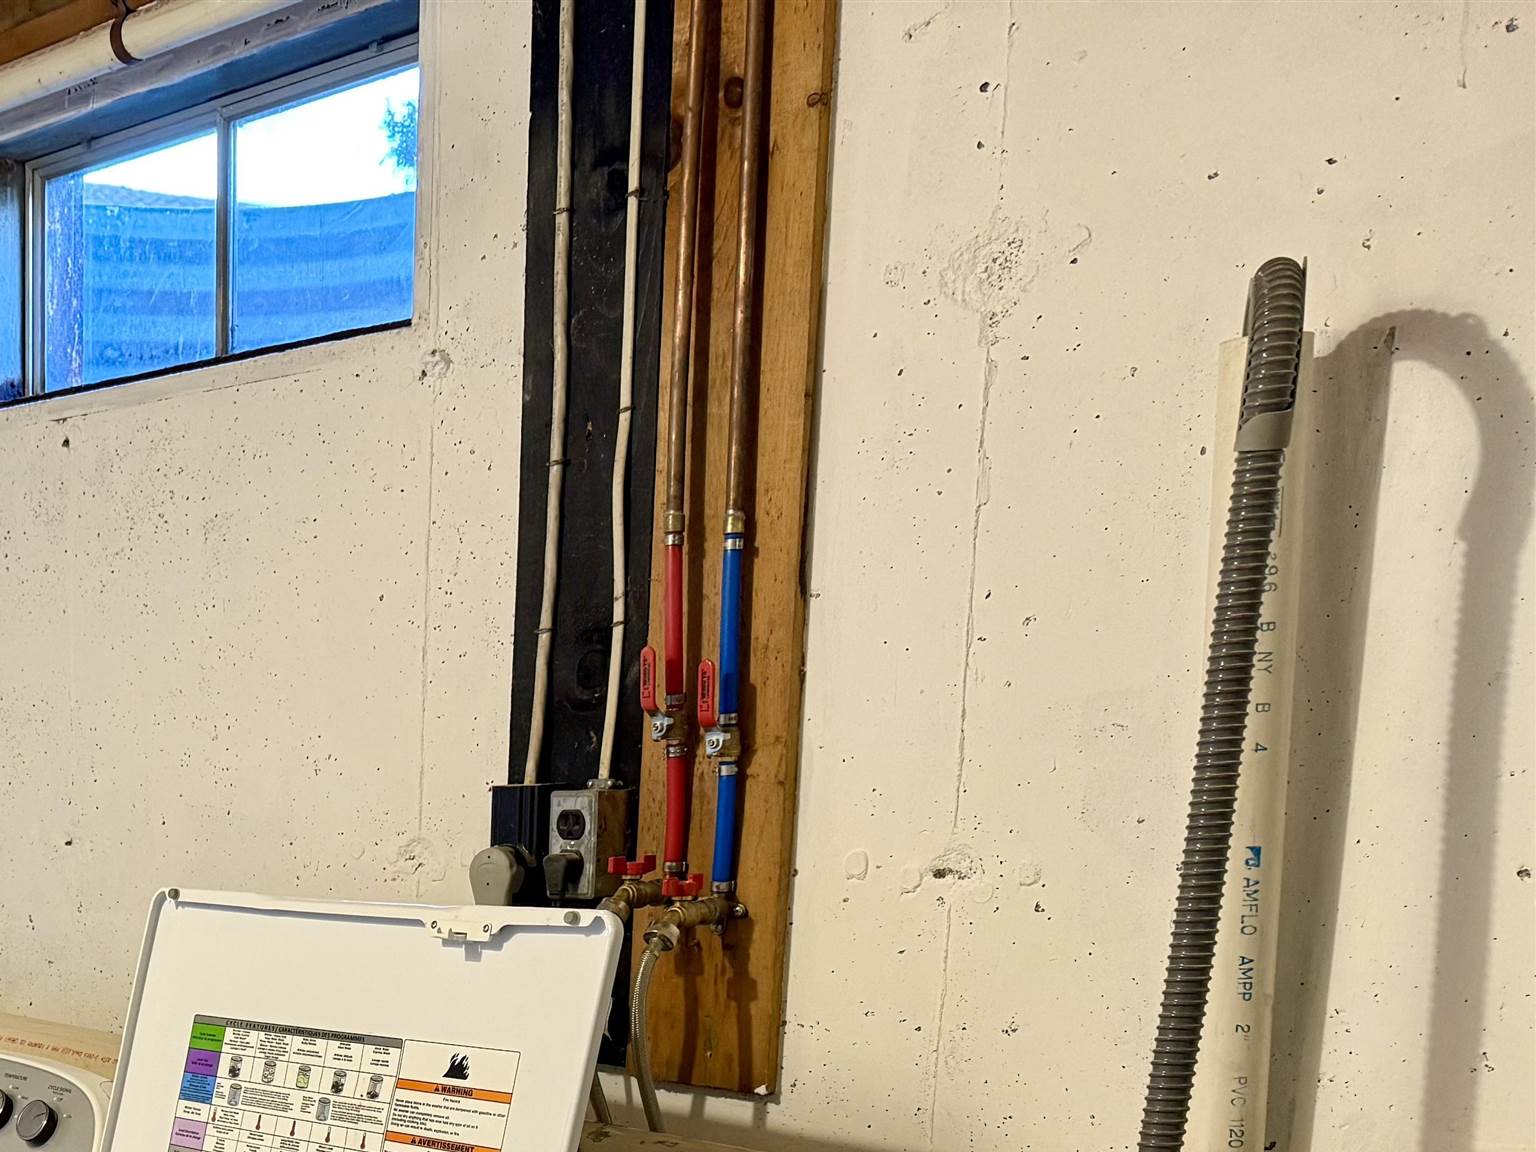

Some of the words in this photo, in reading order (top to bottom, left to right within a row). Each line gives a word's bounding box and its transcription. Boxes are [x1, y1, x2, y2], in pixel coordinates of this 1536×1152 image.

[1256, 651, 1272, 674] NY
[1255, 703, 1270, 713] B
[1254, 742, 1267, 752] 4
[1238, 876, 1261, 937] AMFLO
[1237, 955, 1253, 1001] AMPP
[440, 1086, 473, 1096] WARNING
[1230, 1076, 1246, 1105] PVC
[417, 1138, 474, 1152] AVERTISSEMENT
